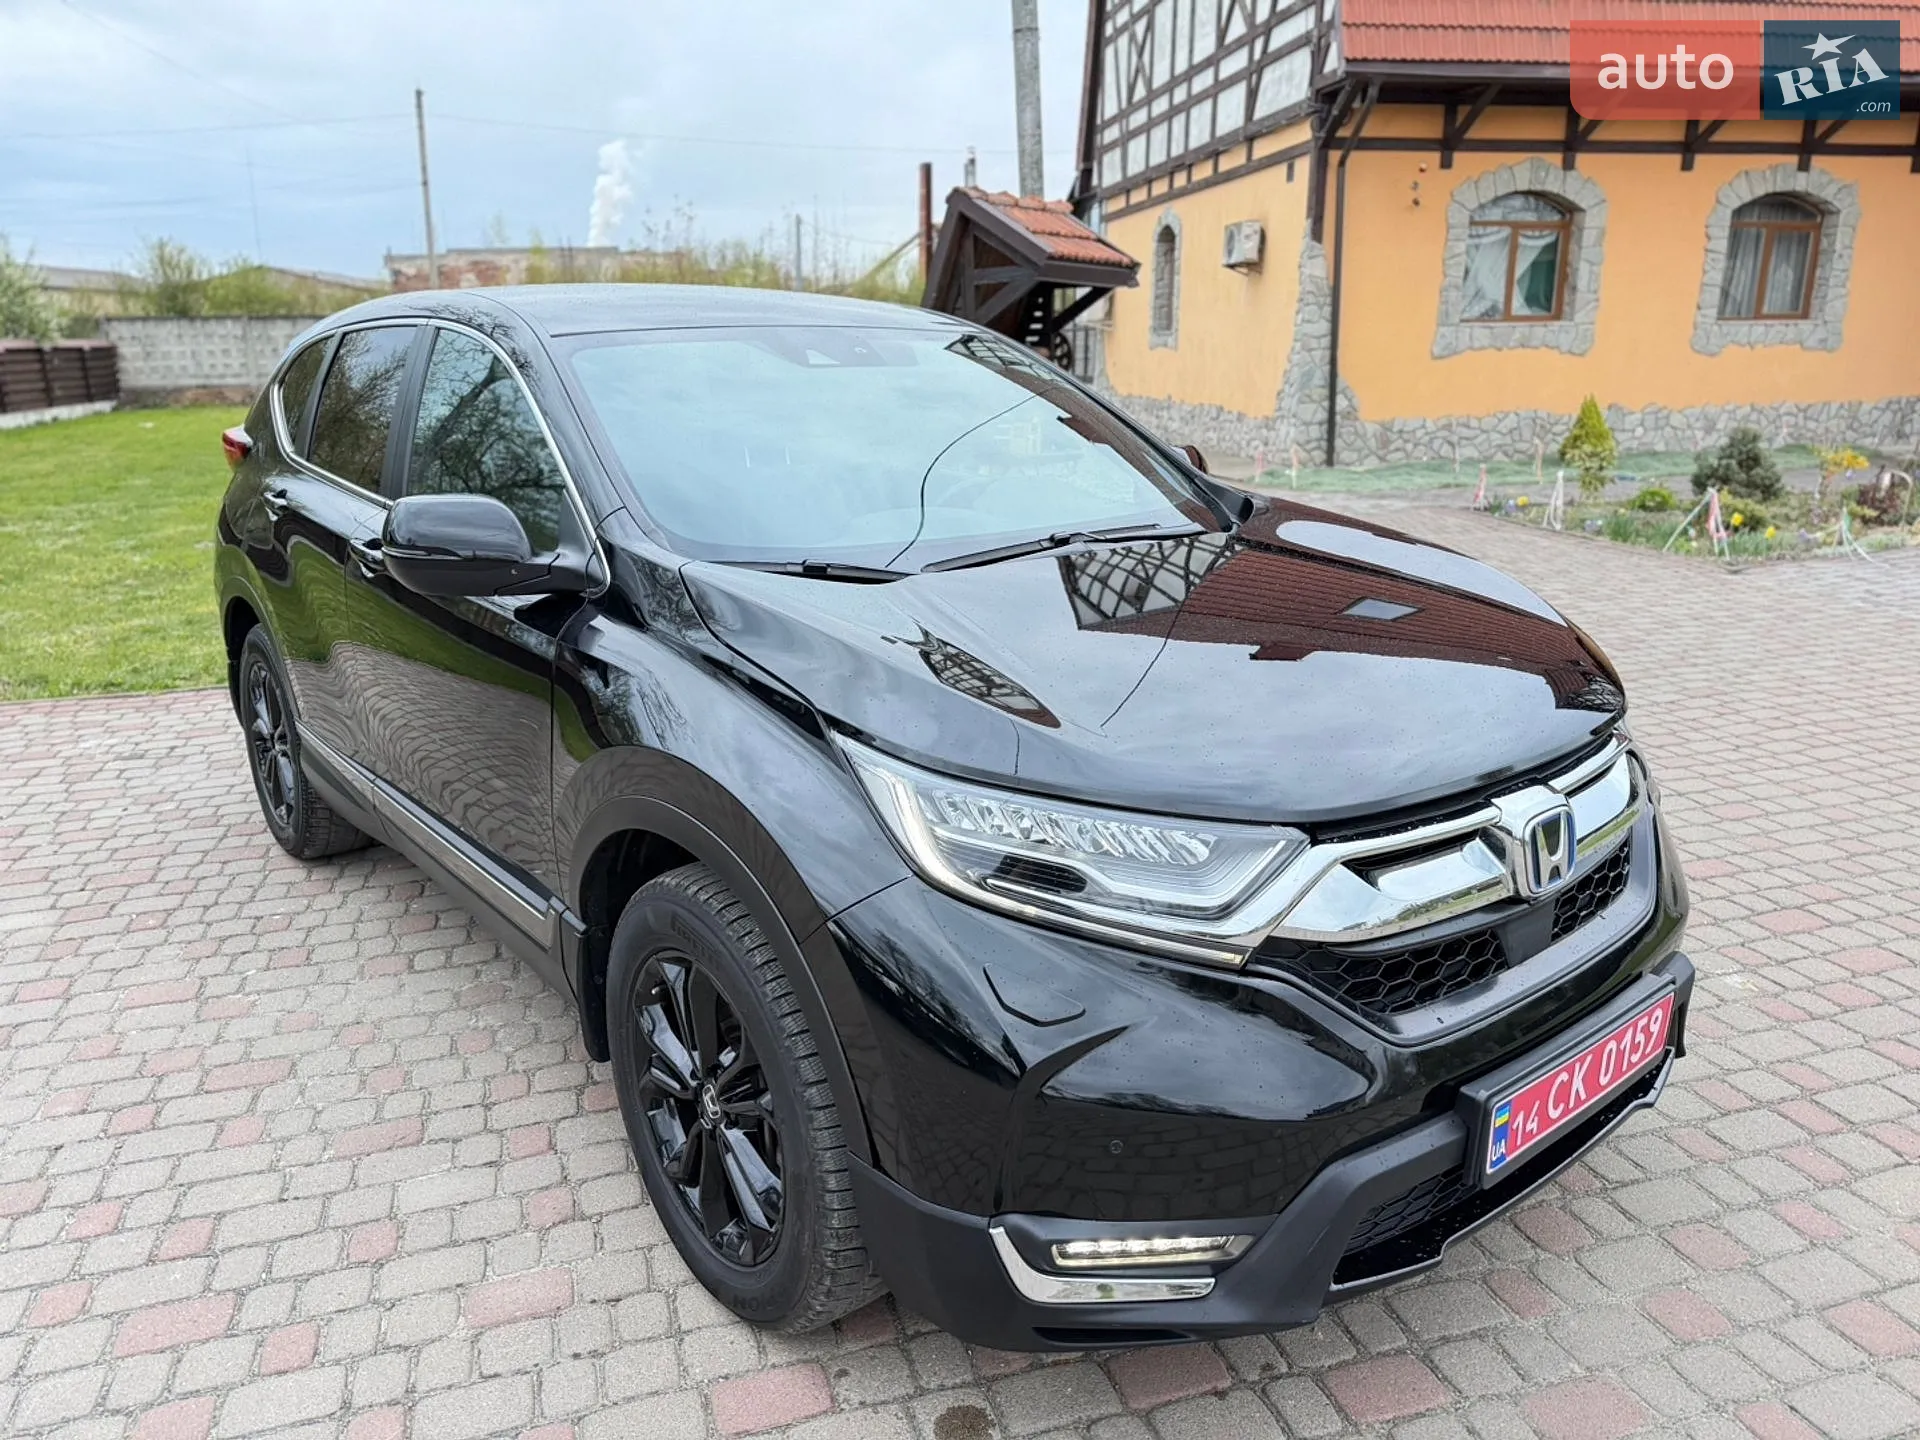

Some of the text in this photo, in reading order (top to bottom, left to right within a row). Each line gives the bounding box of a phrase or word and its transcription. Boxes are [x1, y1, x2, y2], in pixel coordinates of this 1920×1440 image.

[1511, 1007, 1663, 1146] 14 CK 0159
[1491, 1142, 1506, 1161] UA
